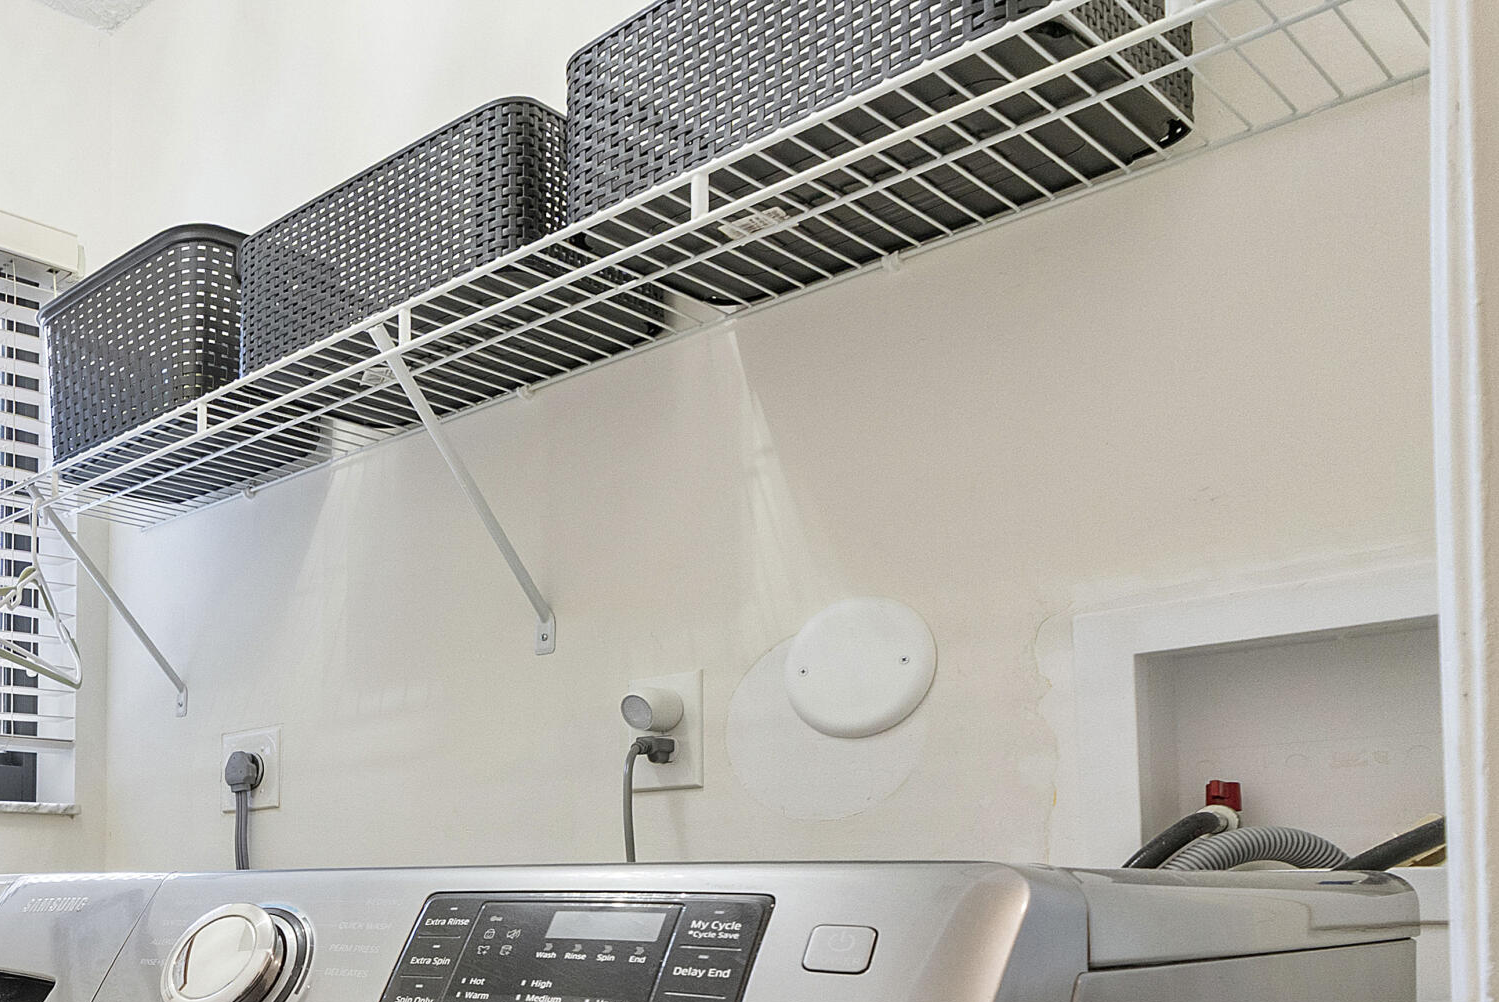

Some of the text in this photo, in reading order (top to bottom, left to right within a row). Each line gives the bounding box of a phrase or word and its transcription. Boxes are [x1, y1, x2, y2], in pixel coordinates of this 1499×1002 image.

[22, 897, 90, 912] SAMSUNG
[425, 918, 470, 927] Extra Rinse
[690, 920, 742, 931] My Cycle
[717, 931, 740, 939] Save
[410, 956, 450, 966] Extra Spin
[536, 951, 647, 964] Wash Rinse Spin End
[672, 966, 731, 979] Delay End
[469, 978, 485, 986] Hot
[530, 979, 553, 989] High
[464, 991, 490, 1000] Warm
